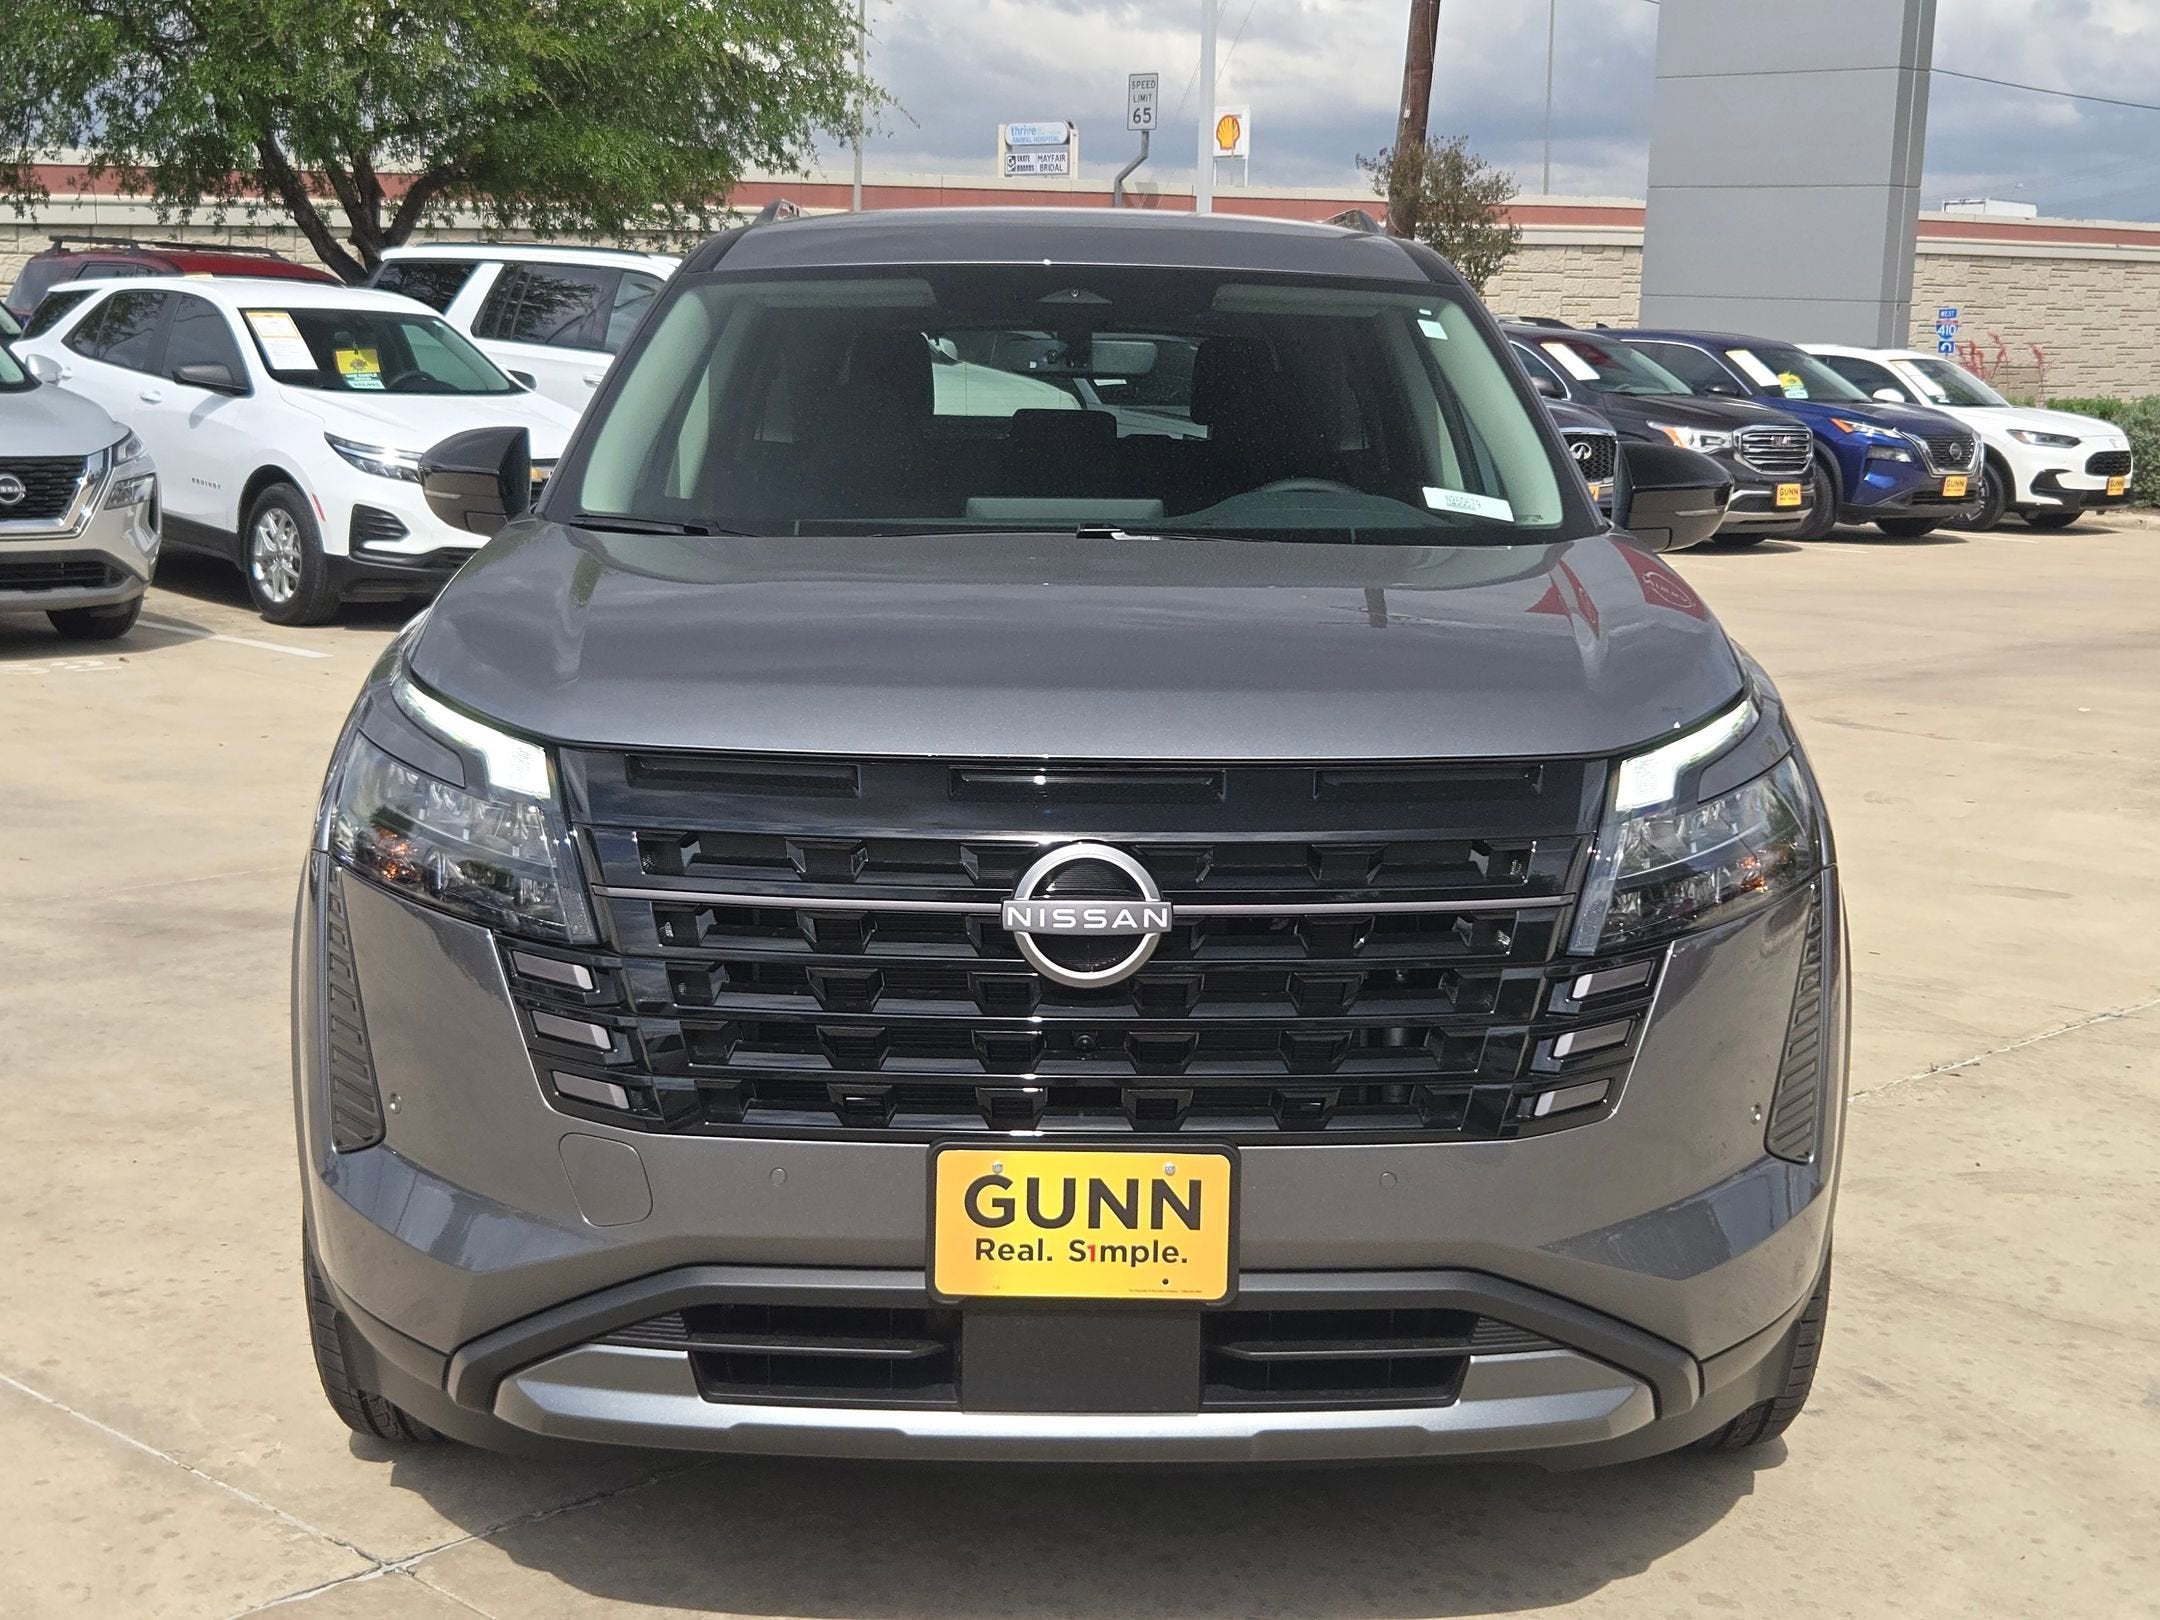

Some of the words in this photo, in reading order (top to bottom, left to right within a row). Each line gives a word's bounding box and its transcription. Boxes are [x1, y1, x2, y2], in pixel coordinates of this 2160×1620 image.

[1131, 80, 1156, 90] SPEED
[1133, 93, 1152, 103] LIMIT
[1133, 107, 1152, 124] 65
[1011, 124, 1037, 136] thrive
[1038, 154, 1066, 163] MAYFAIR
[1039, 163, 1064, 172] BRIDAL
[1937, 324, 1957, 336] 410
[1945, 479, 1964, 488] GUNN
[1779, 487, 1799, 496] GUNN
[1007, 906, 1168, 930] NISSAN
[963, 1174, 1203, 1231] GUNN
[975, 1237, 1054, 1262] Real.
